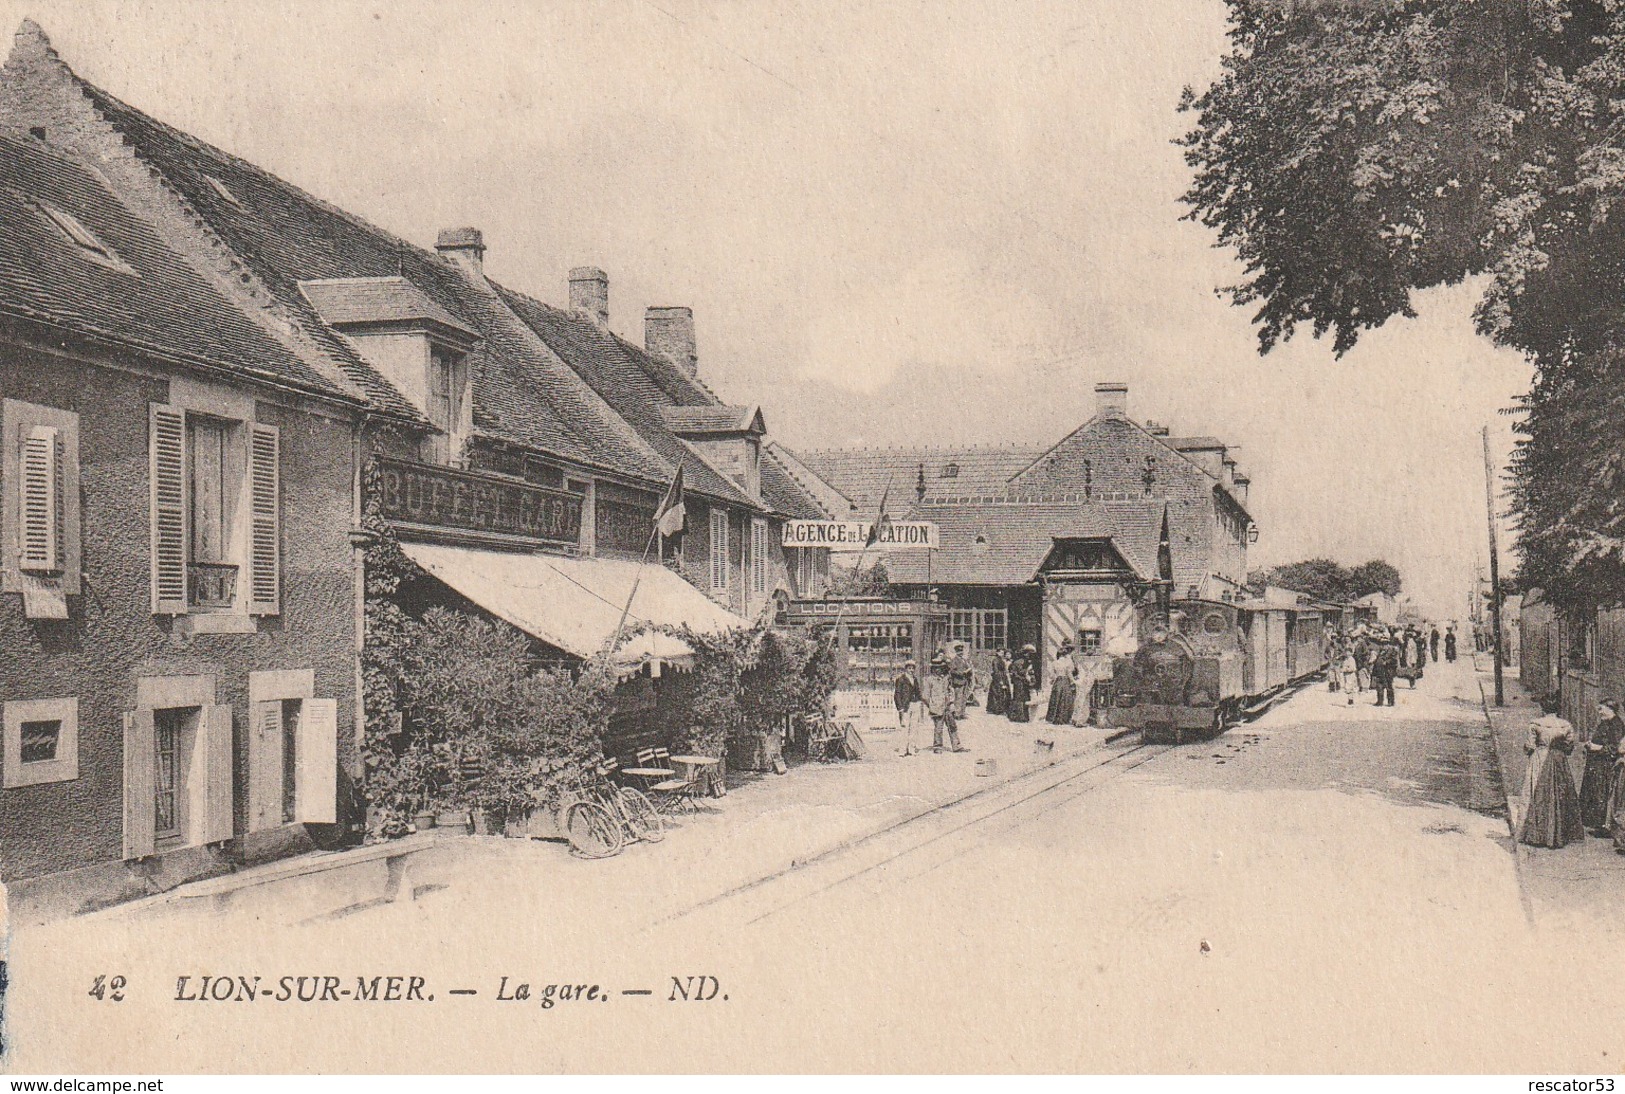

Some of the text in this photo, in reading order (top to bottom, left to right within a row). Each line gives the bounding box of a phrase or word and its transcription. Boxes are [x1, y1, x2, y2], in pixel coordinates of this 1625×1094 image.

[783, 522, 847, 543] AGENCE
[857, 523, 930, 544] LCATION
[800, 602, 911, 614] LOCATIONS
